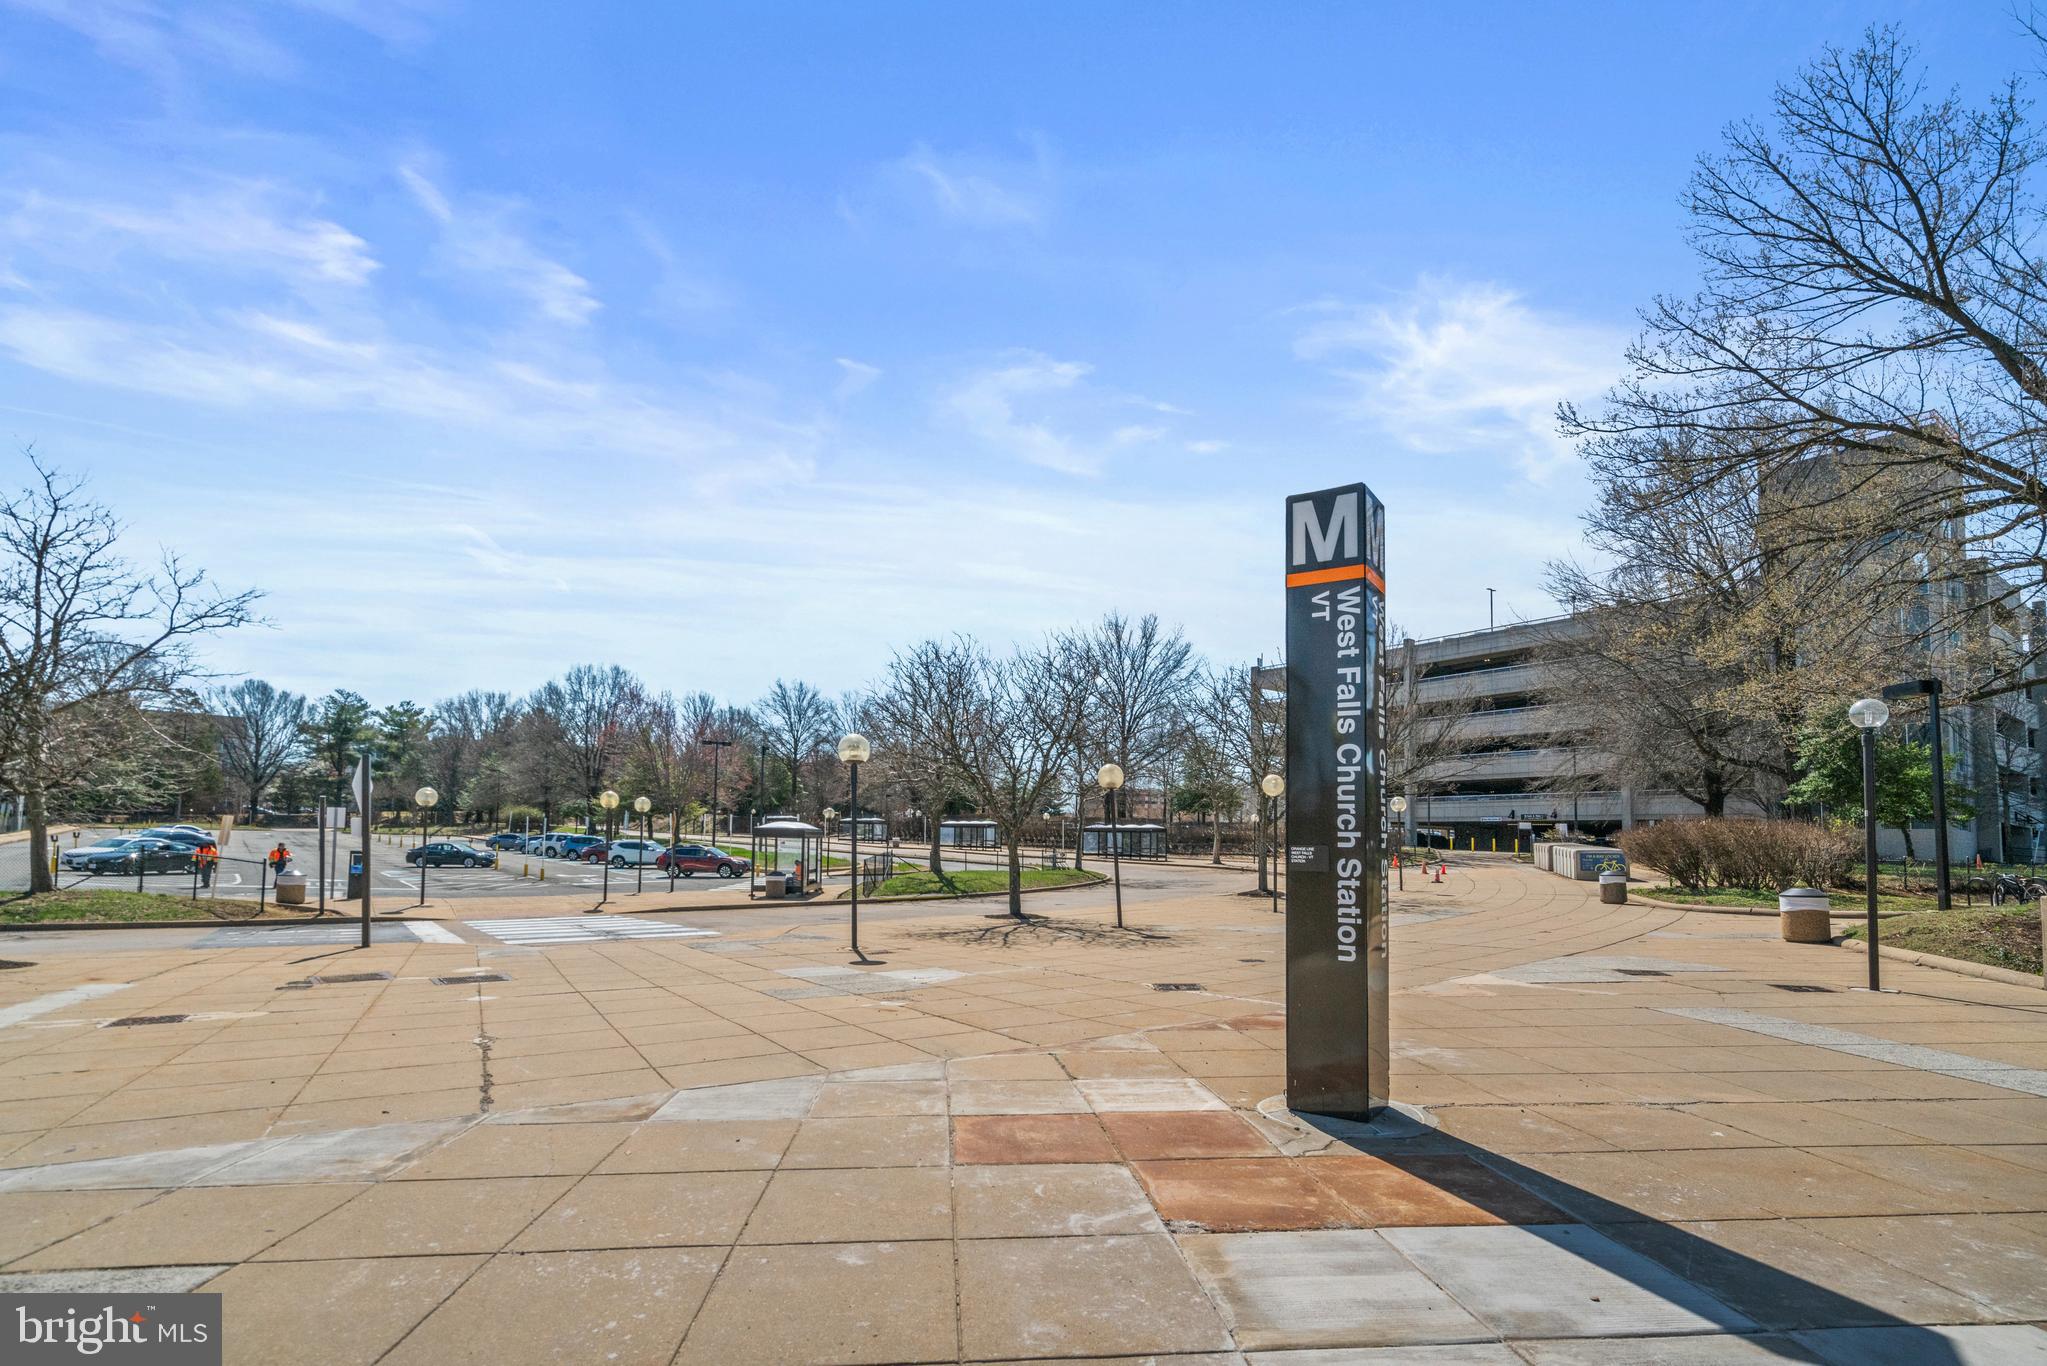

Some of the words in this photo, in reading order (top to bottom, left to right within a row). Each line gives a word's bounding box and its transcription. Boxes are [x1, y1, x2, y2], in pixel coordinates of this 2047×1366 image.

[1292, 492, 1358, 566] M
[1365, 494, 1384, 572] M
[1311, 590, 1330, 621] VT
[1337, 585, 1361, 659] West
[1337, 667, 1361, 735] Falls
[1337, 743, 1361, 848] Church
[1379, 748, 1388, 849] Church
[1337, 858, 1362, 962] Station
[1380, 858, 1388, 959] Station
